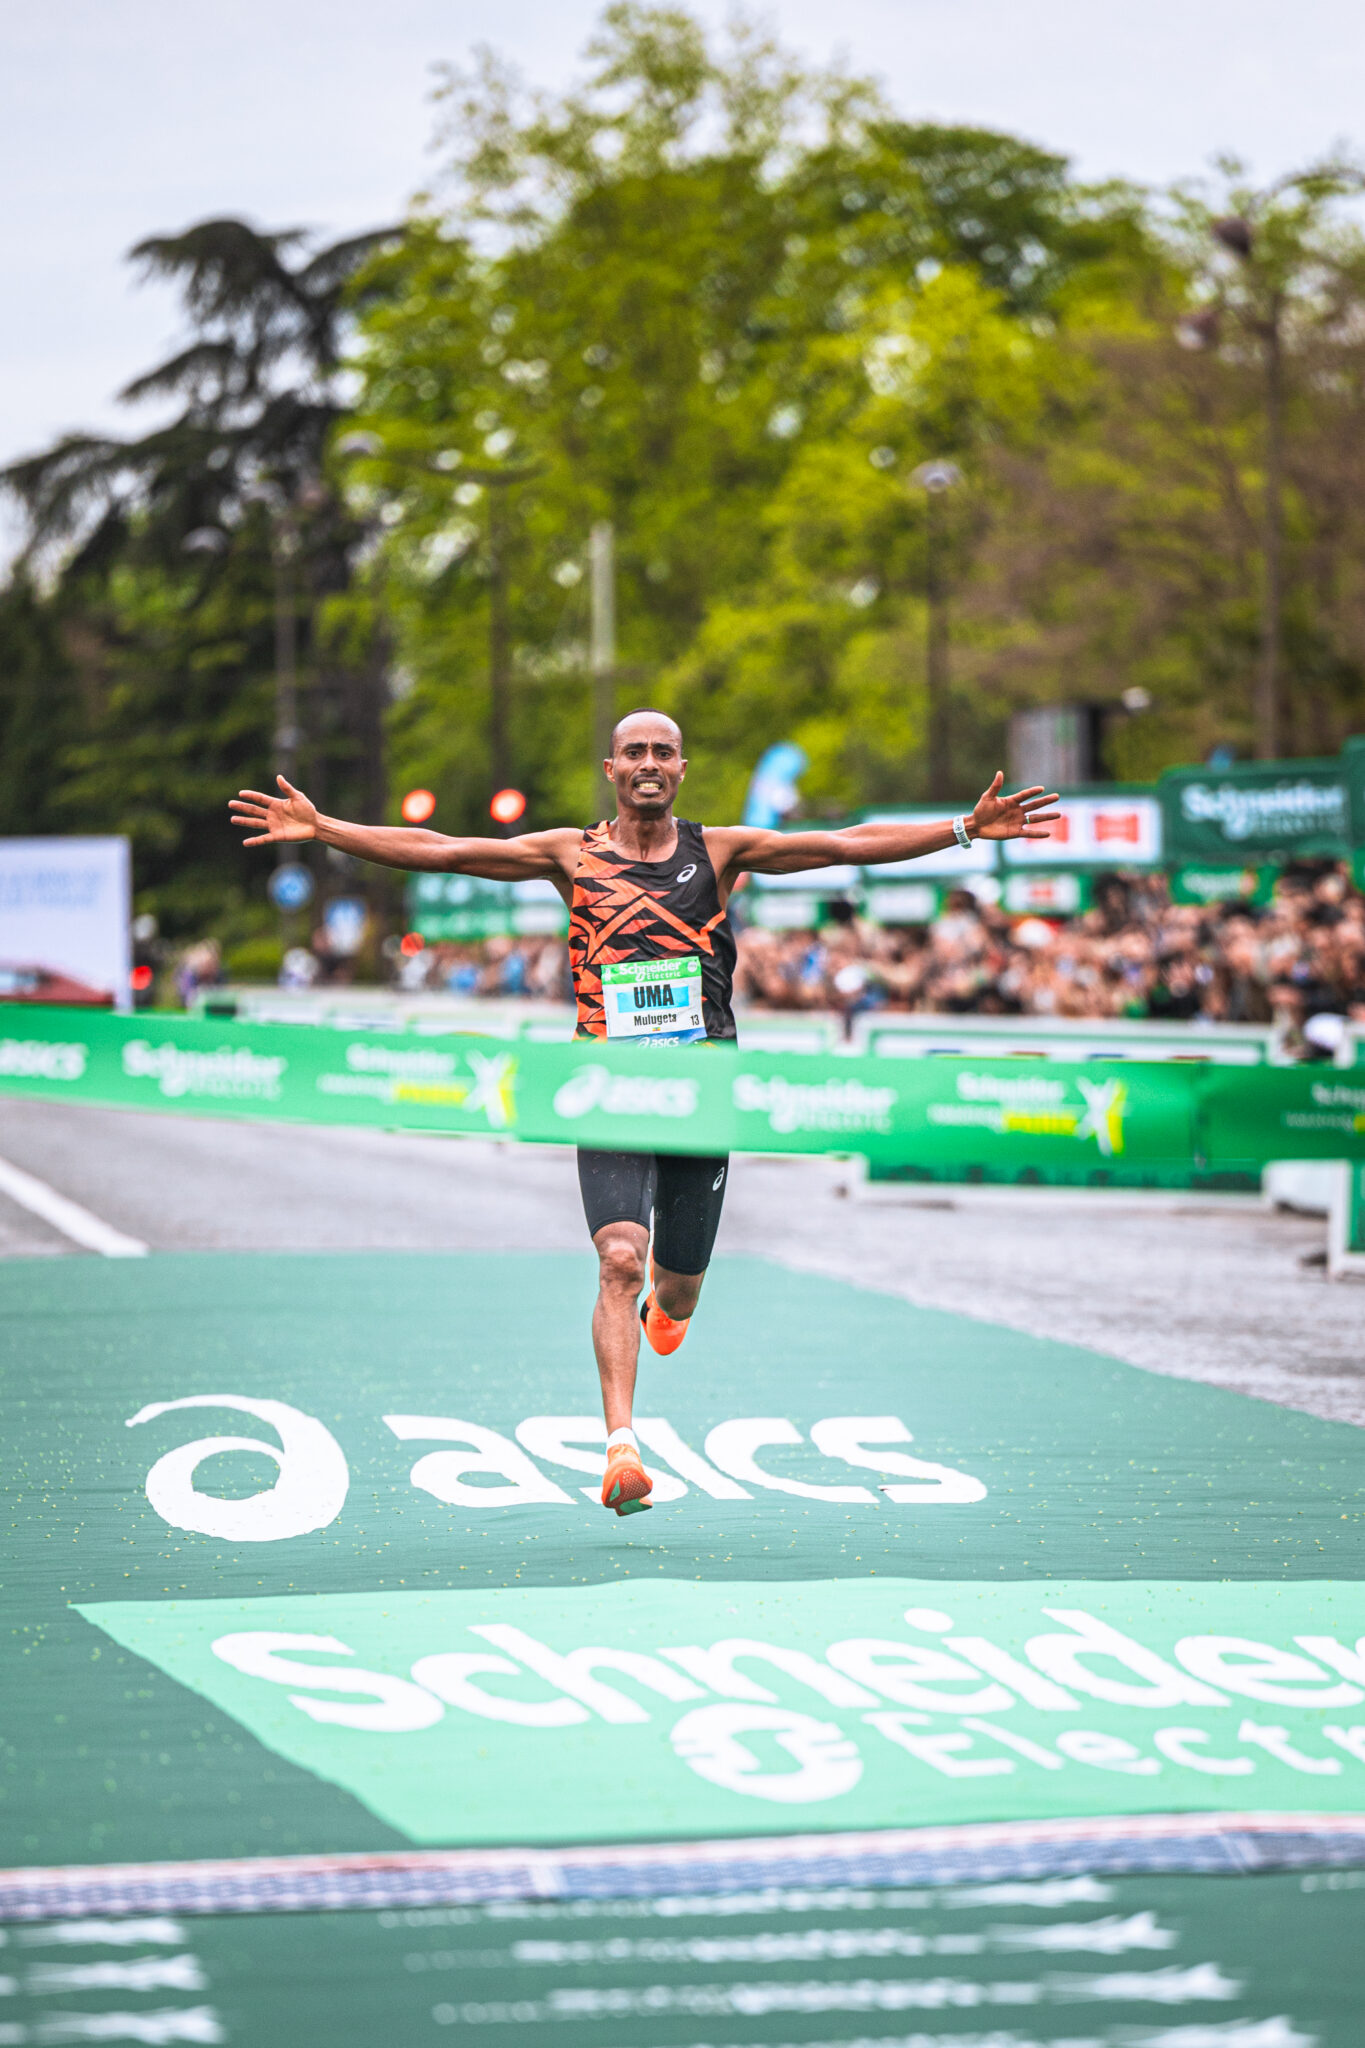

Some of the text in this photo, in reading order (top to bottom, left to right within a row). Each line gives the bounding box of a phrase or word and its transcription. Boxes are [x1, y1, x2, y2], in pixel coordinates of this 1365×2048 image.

[620, 960, 681, 976] Schneider
[647, 972, 681, 980] Electric
[633, 984, 675, 1009] UMA
[633, 1013, 677, 1026] Mulugeta
[690, 1014, 700, 1026] 13
[383, 1415, 987, 1507] asics
